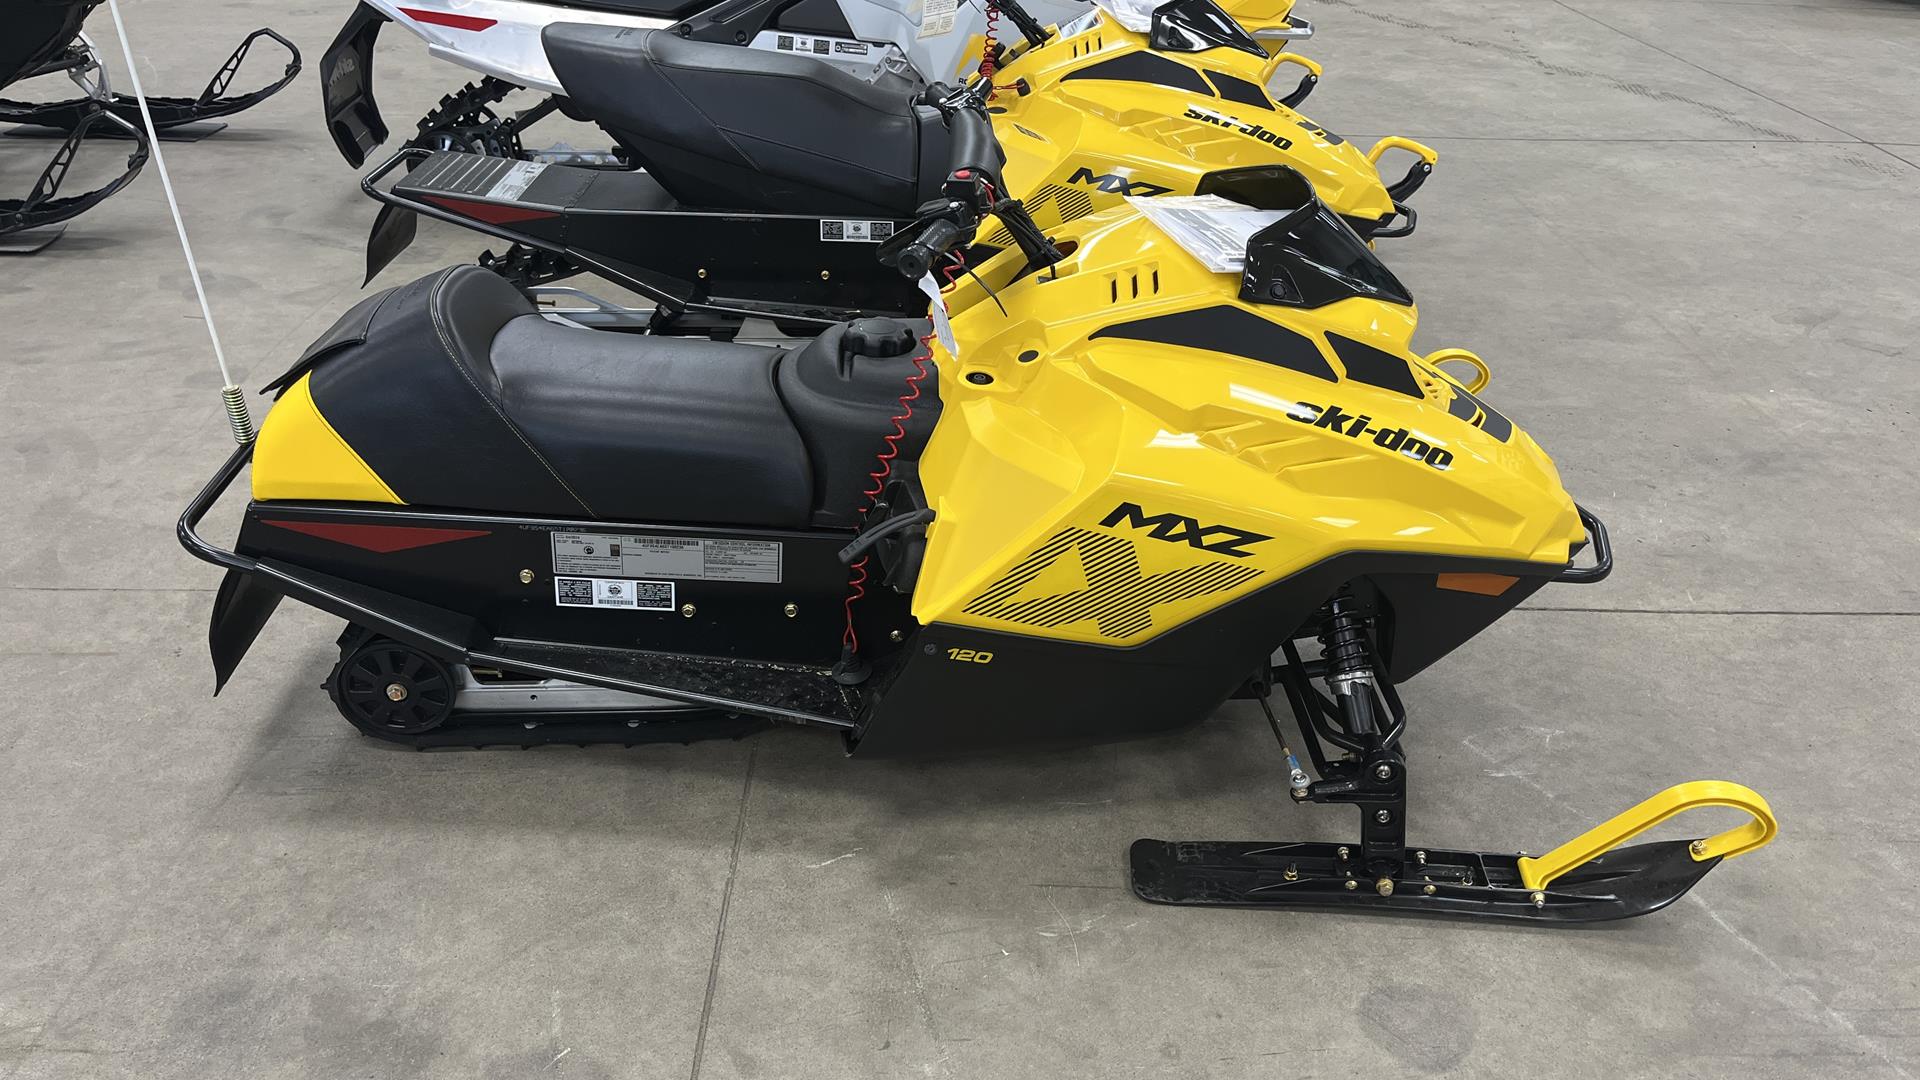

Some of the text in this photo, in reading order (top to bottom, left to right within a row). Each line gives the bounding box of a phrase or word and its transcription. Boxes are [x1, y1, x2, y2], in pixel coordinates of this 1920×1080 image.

[1183, 103, 1294, 151] Ski-doo
[1286, 401, 1455, 471] Ski-doo
[1098, 501, 1275, 558] MXZ
[947, 647, 994, 664] 120
